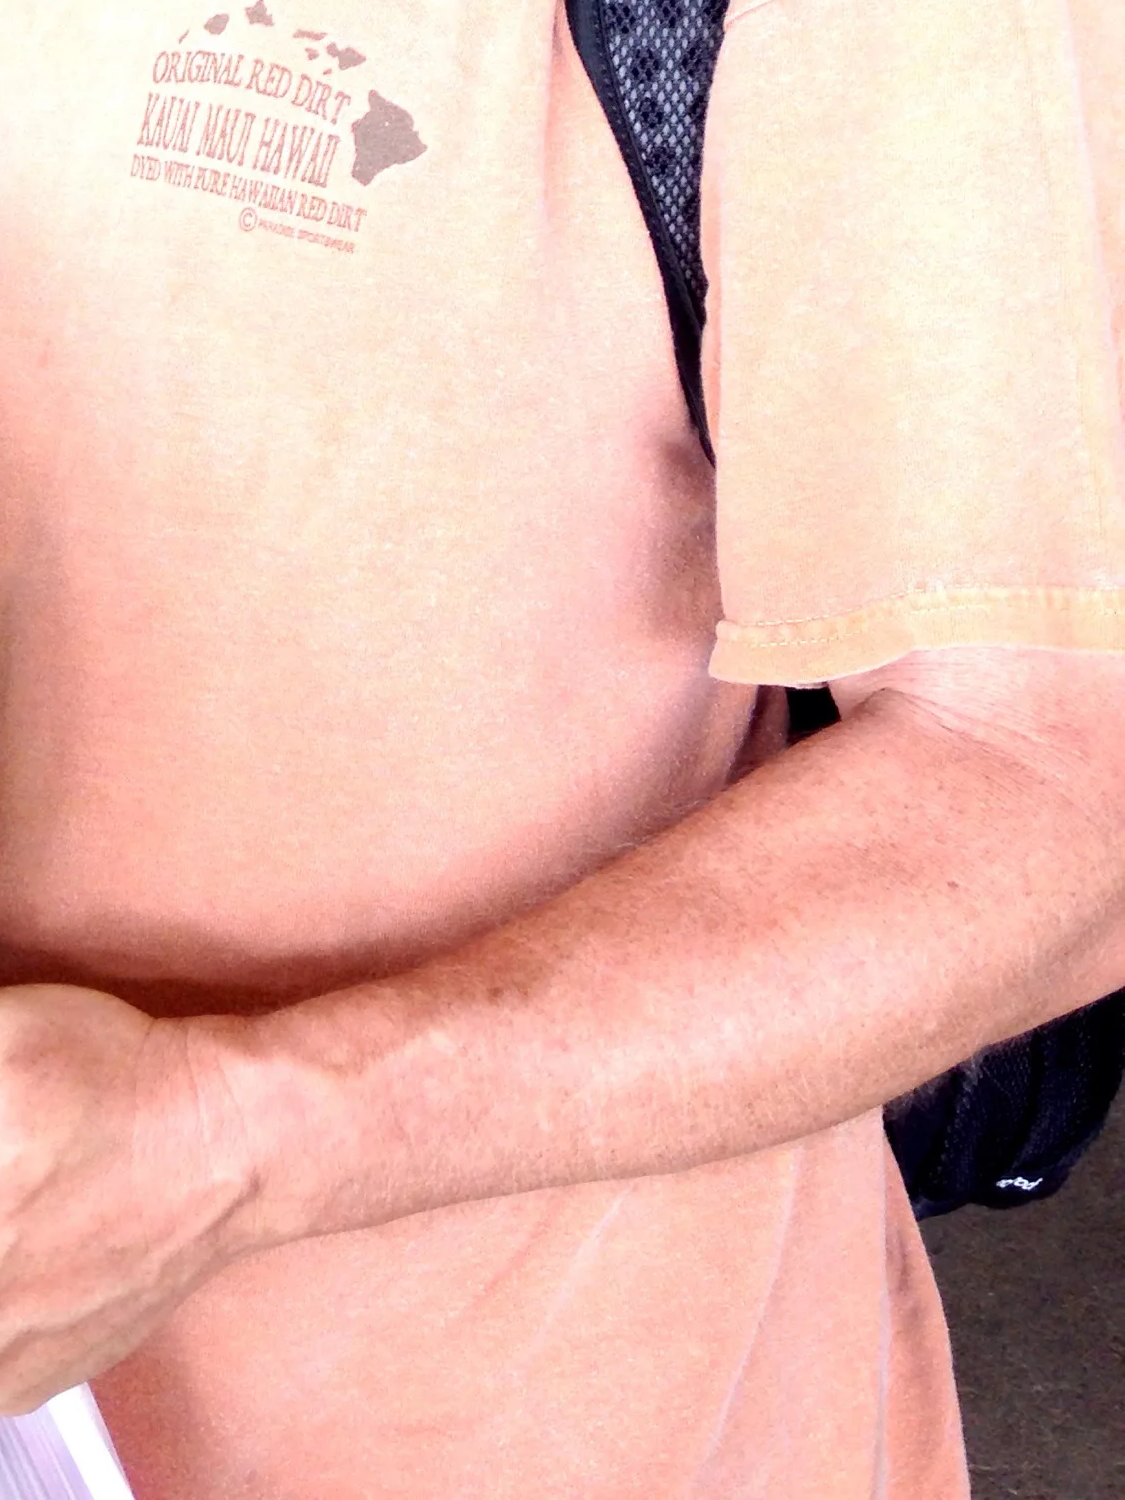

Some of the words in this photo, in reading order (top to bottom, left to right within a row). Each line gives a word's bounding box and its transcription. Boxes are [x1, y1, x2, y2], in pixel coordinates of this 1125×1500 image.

[153, 51, 244, 87] ORIGINAL
[246, 58, 292, 99] RED
[292, 73, 351, 125] DIRT
[137, 93, 200, 153] KAUAI
[196, 103, 255, 166] MAUI
[252, 118, 341, 188] HAWAII
[130, 154, 161, 181] DYED
[164, 161, 194, 188] WITH
[194, 167, 230, 196] PURE
[229, 175, 297, 214] HAWAIIAN
[296, 193, 328, 222] RED
[327, 201, 367, 232] DIRT
